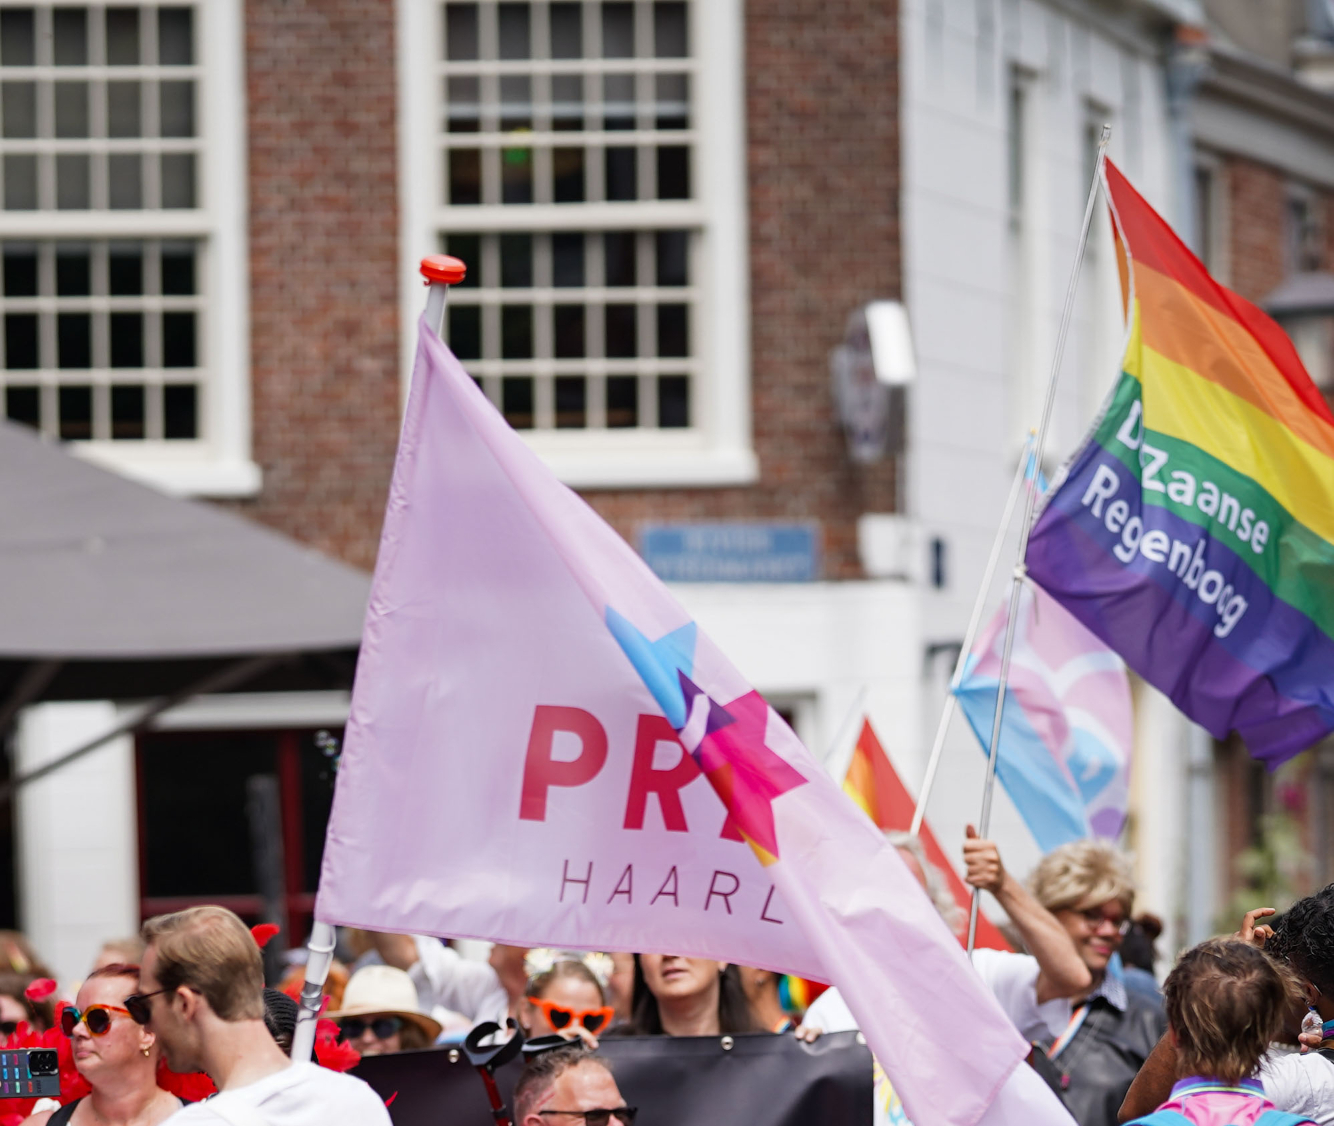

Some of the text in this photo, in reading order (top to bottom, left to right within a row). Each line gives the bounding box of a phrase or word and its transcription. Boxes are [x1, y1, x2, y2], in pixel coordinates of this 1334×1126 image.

[1142, 442, 1269, 554] Zaanse
[519, 704, 746, 844] PR
[559, 858, 784, 924] HAARL
